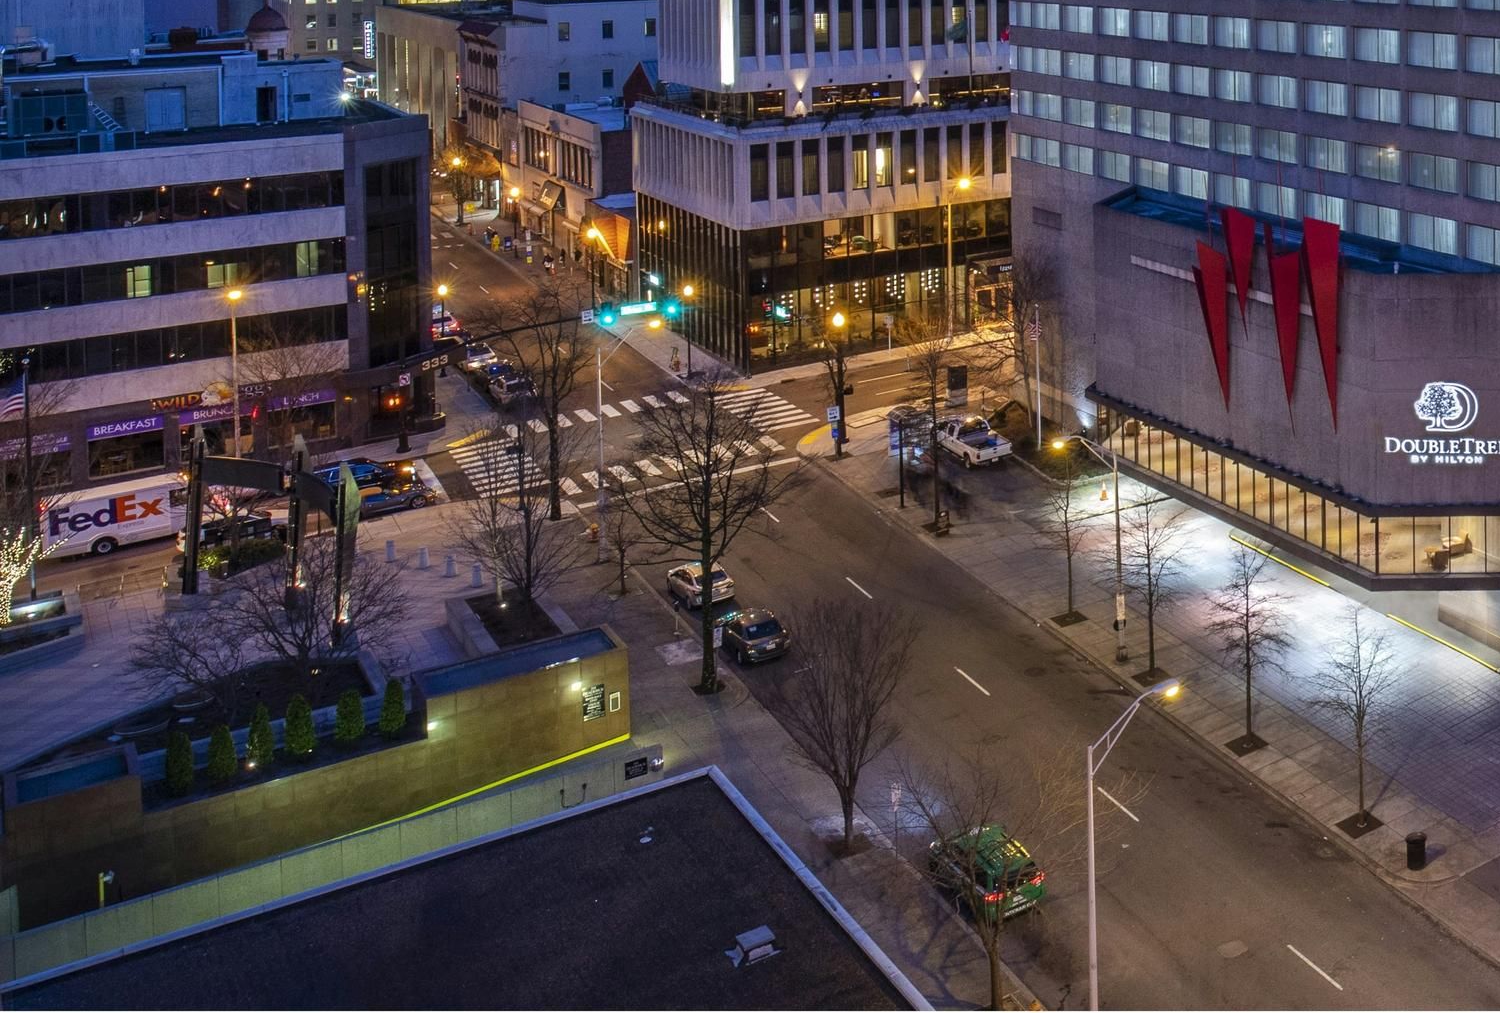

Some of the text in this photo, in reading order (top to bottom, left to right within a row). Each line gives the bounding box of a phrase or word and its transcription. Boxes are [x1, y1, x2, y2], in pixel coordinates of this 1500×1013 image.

[421, 354, 449, 371] 333
[283, 392, 319, 405] LNCH
[193, 405, 237, 420] BRUNC
[93, 417, 157, 436] BREAKFAST
[1410, 455, 1483, 464] BY HILTON
[49, 494, 164, 536] FedEx
